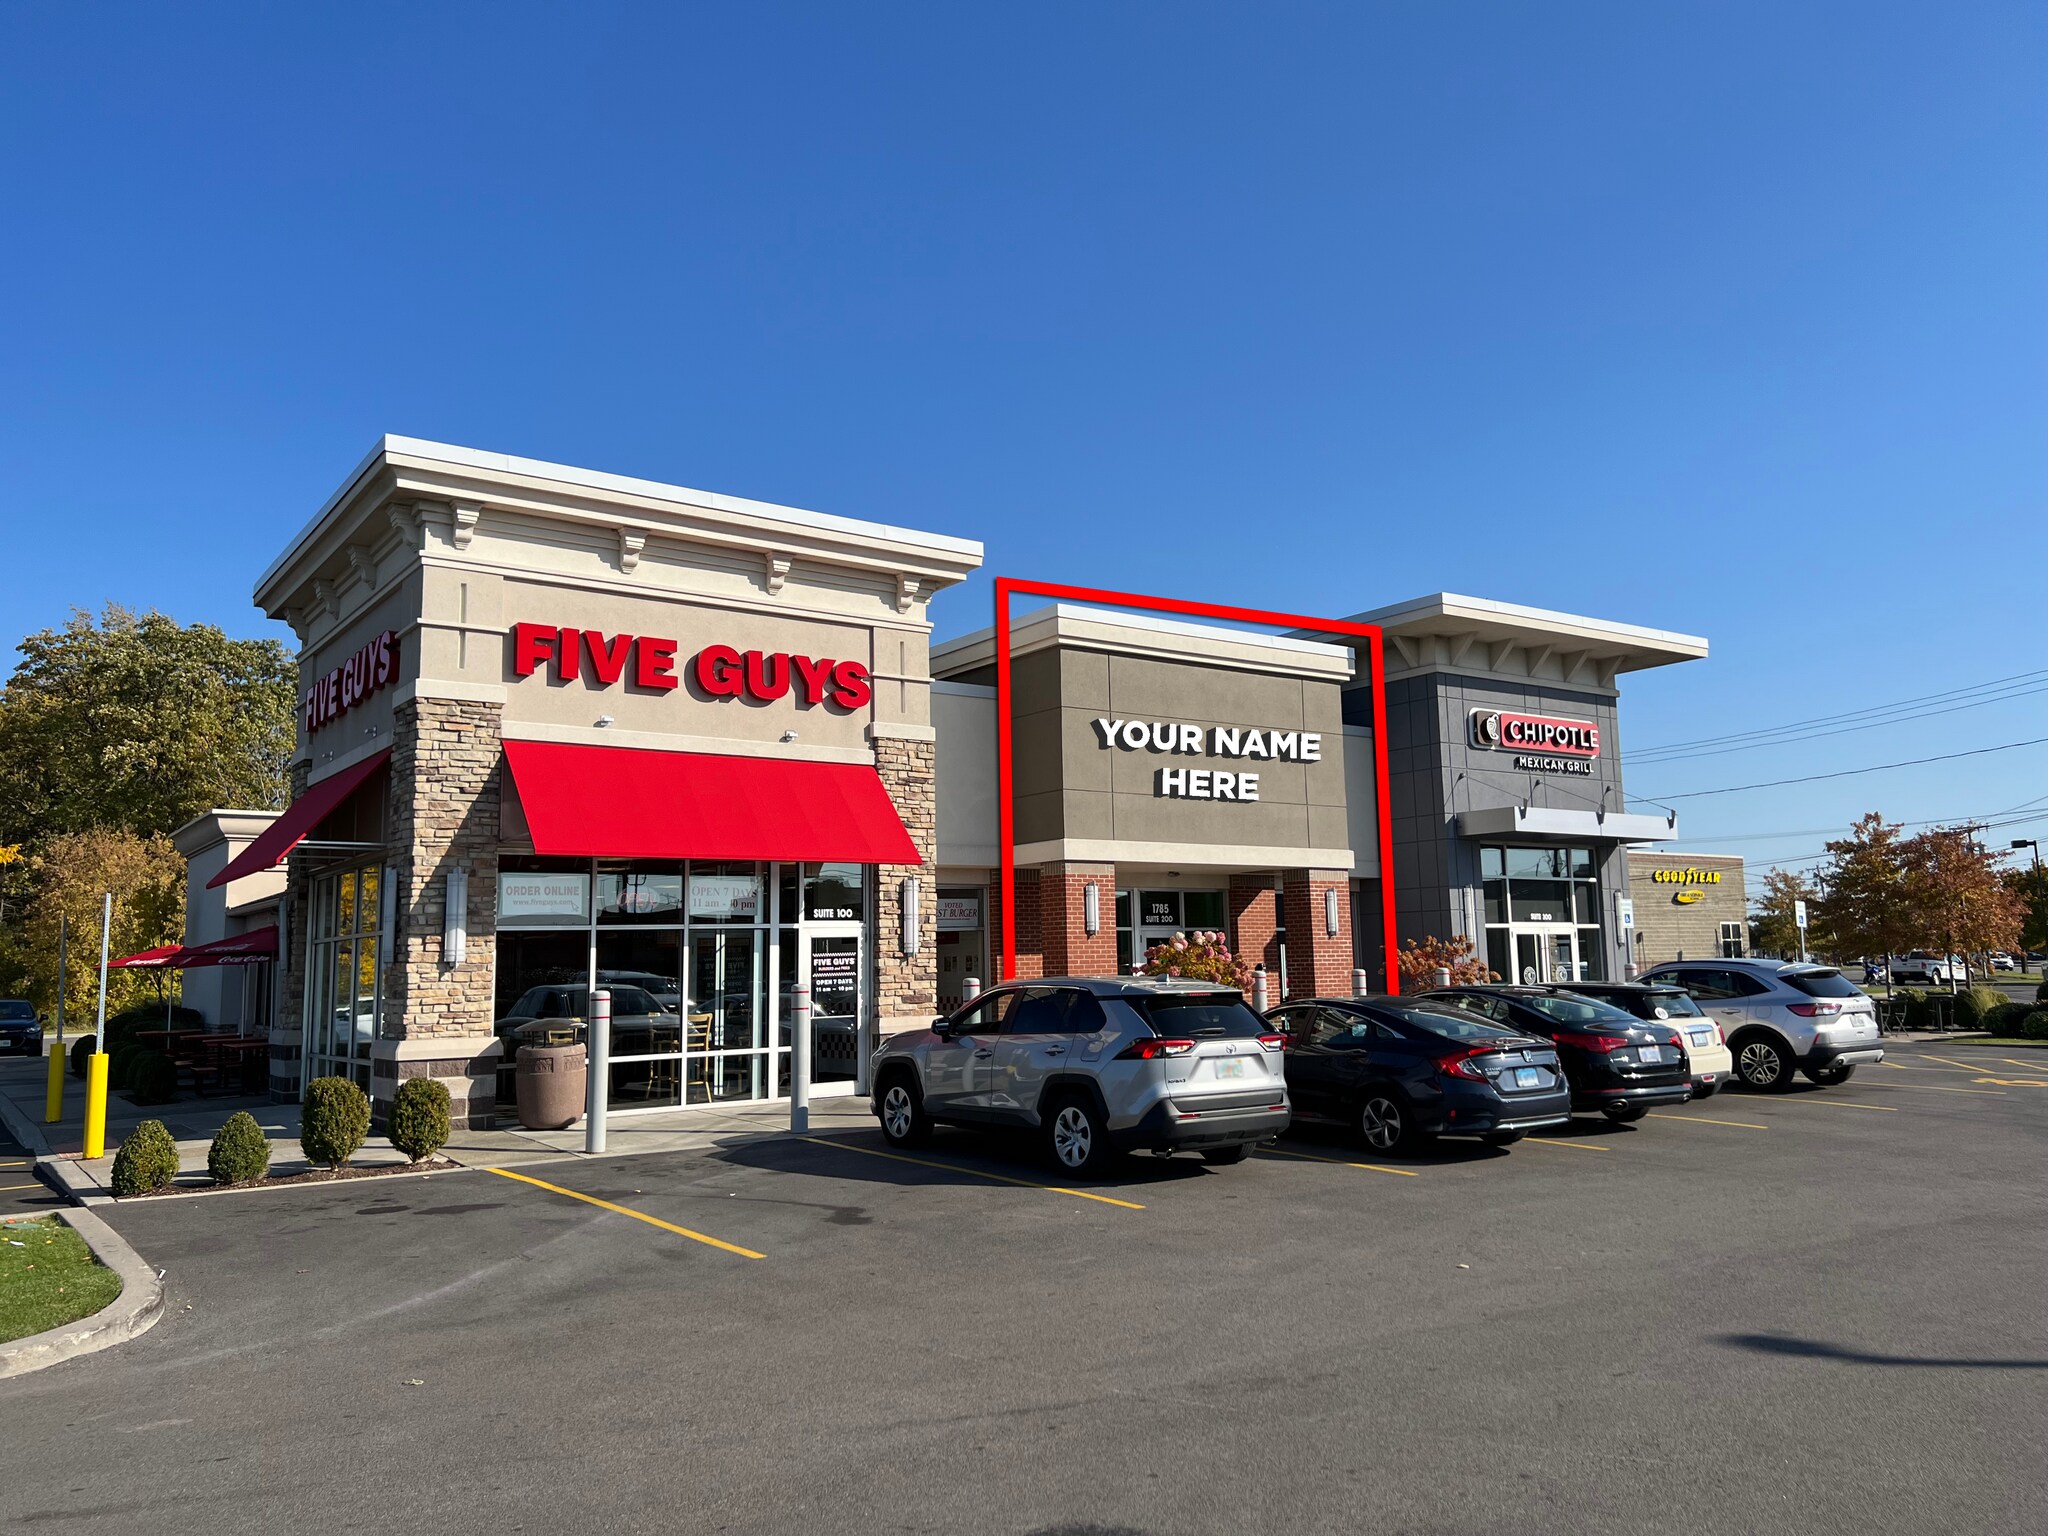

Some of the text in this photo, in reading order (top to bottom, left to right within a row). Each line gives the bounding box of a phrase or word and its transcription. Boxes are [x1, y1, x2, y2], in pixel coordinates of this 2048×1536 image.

[514, 622, 871, 709] FIVE GUYS
[305, 630, 394, 732] FIVE GUYS
[1510, 720, 1599, 747] CHIPOTLE
[1519, 756, 1594, 773] MEXICAN GRILL
[506, 885, 580, 896] ORDER ONLINE
[692, 885, 757, 897] OPEN 7 DAYS
[693, 898, 702, 907] 11
[741, 901, 755, 910] pm
[1152, 903, 1169, 914] 1785
[813, 908, 853, 918] SUITE 100
[950, 909, 977, 917] BURGER
[1145, 915, 1173, 923] SUITE 200
[813, 957, 855, 966] FIVE GUYS
